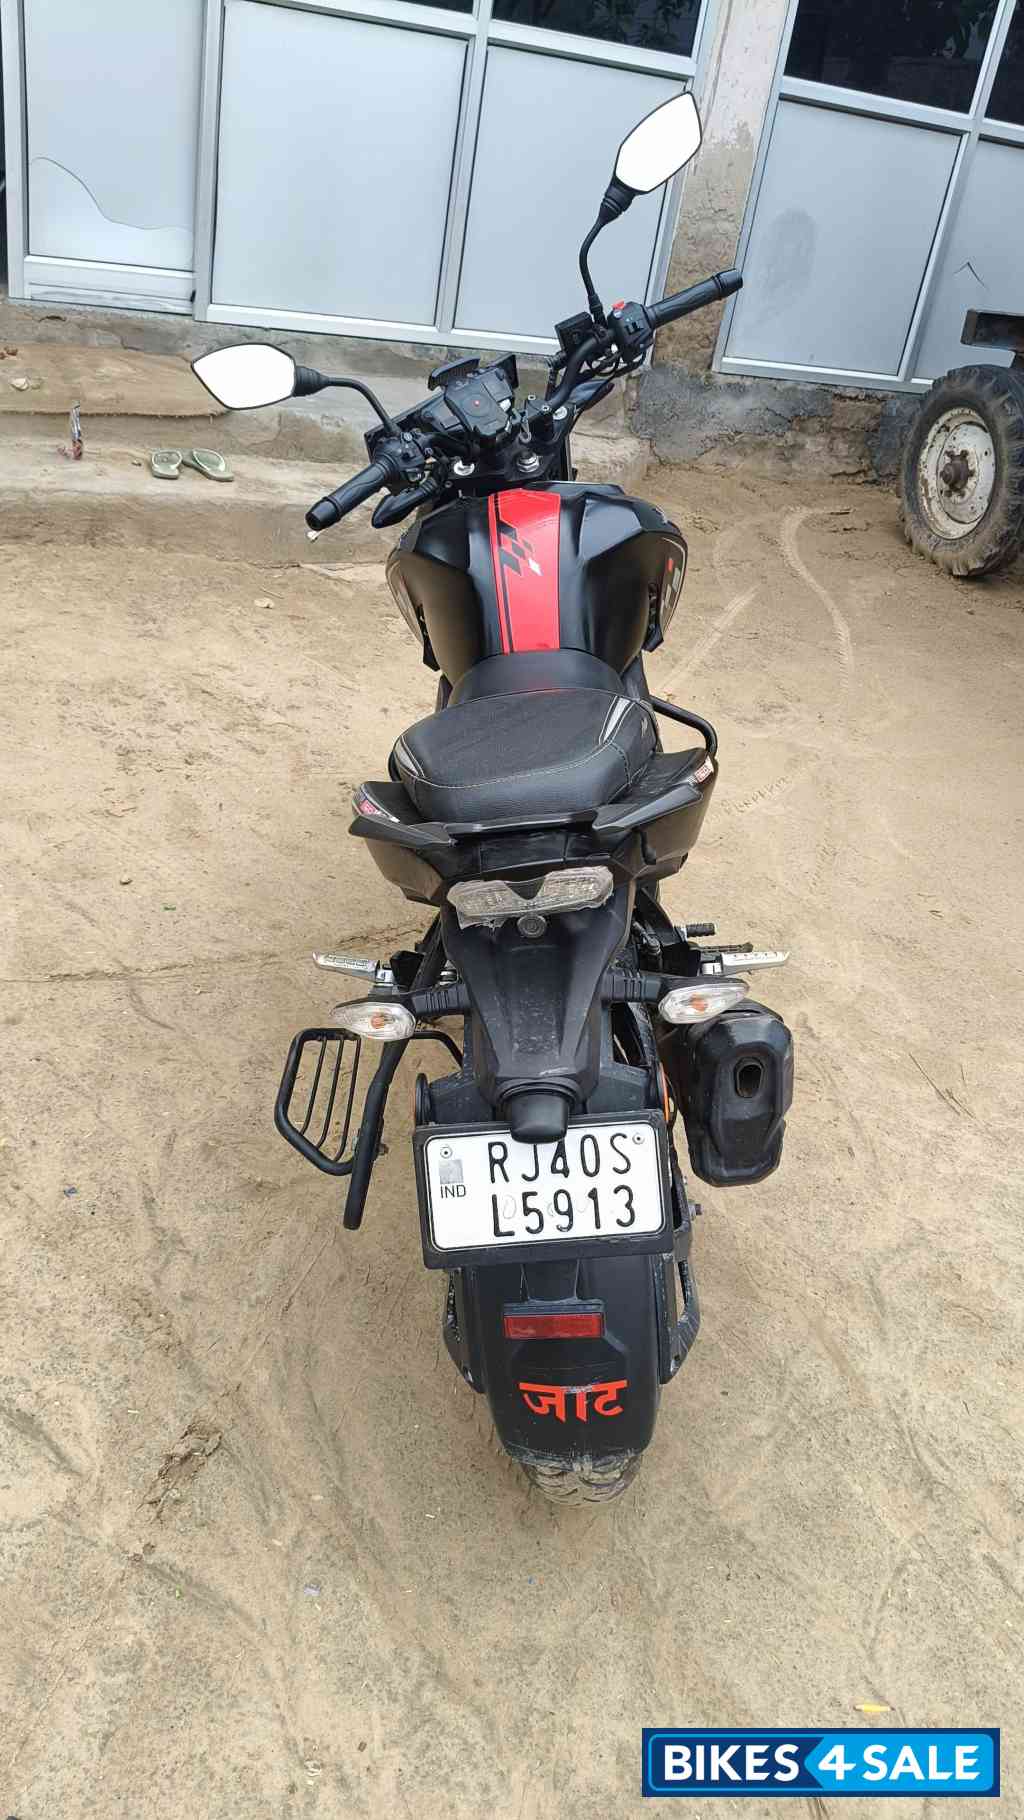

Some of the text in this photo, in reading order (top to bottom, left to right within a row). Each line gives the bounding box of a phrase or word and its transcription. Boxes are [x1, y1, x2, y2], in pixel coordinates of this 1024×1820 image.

[439, 1184, 467, 1199] IND
[491, 1184, 636, 1237] L5913
[518, 1378, 628, 1423] जाट
